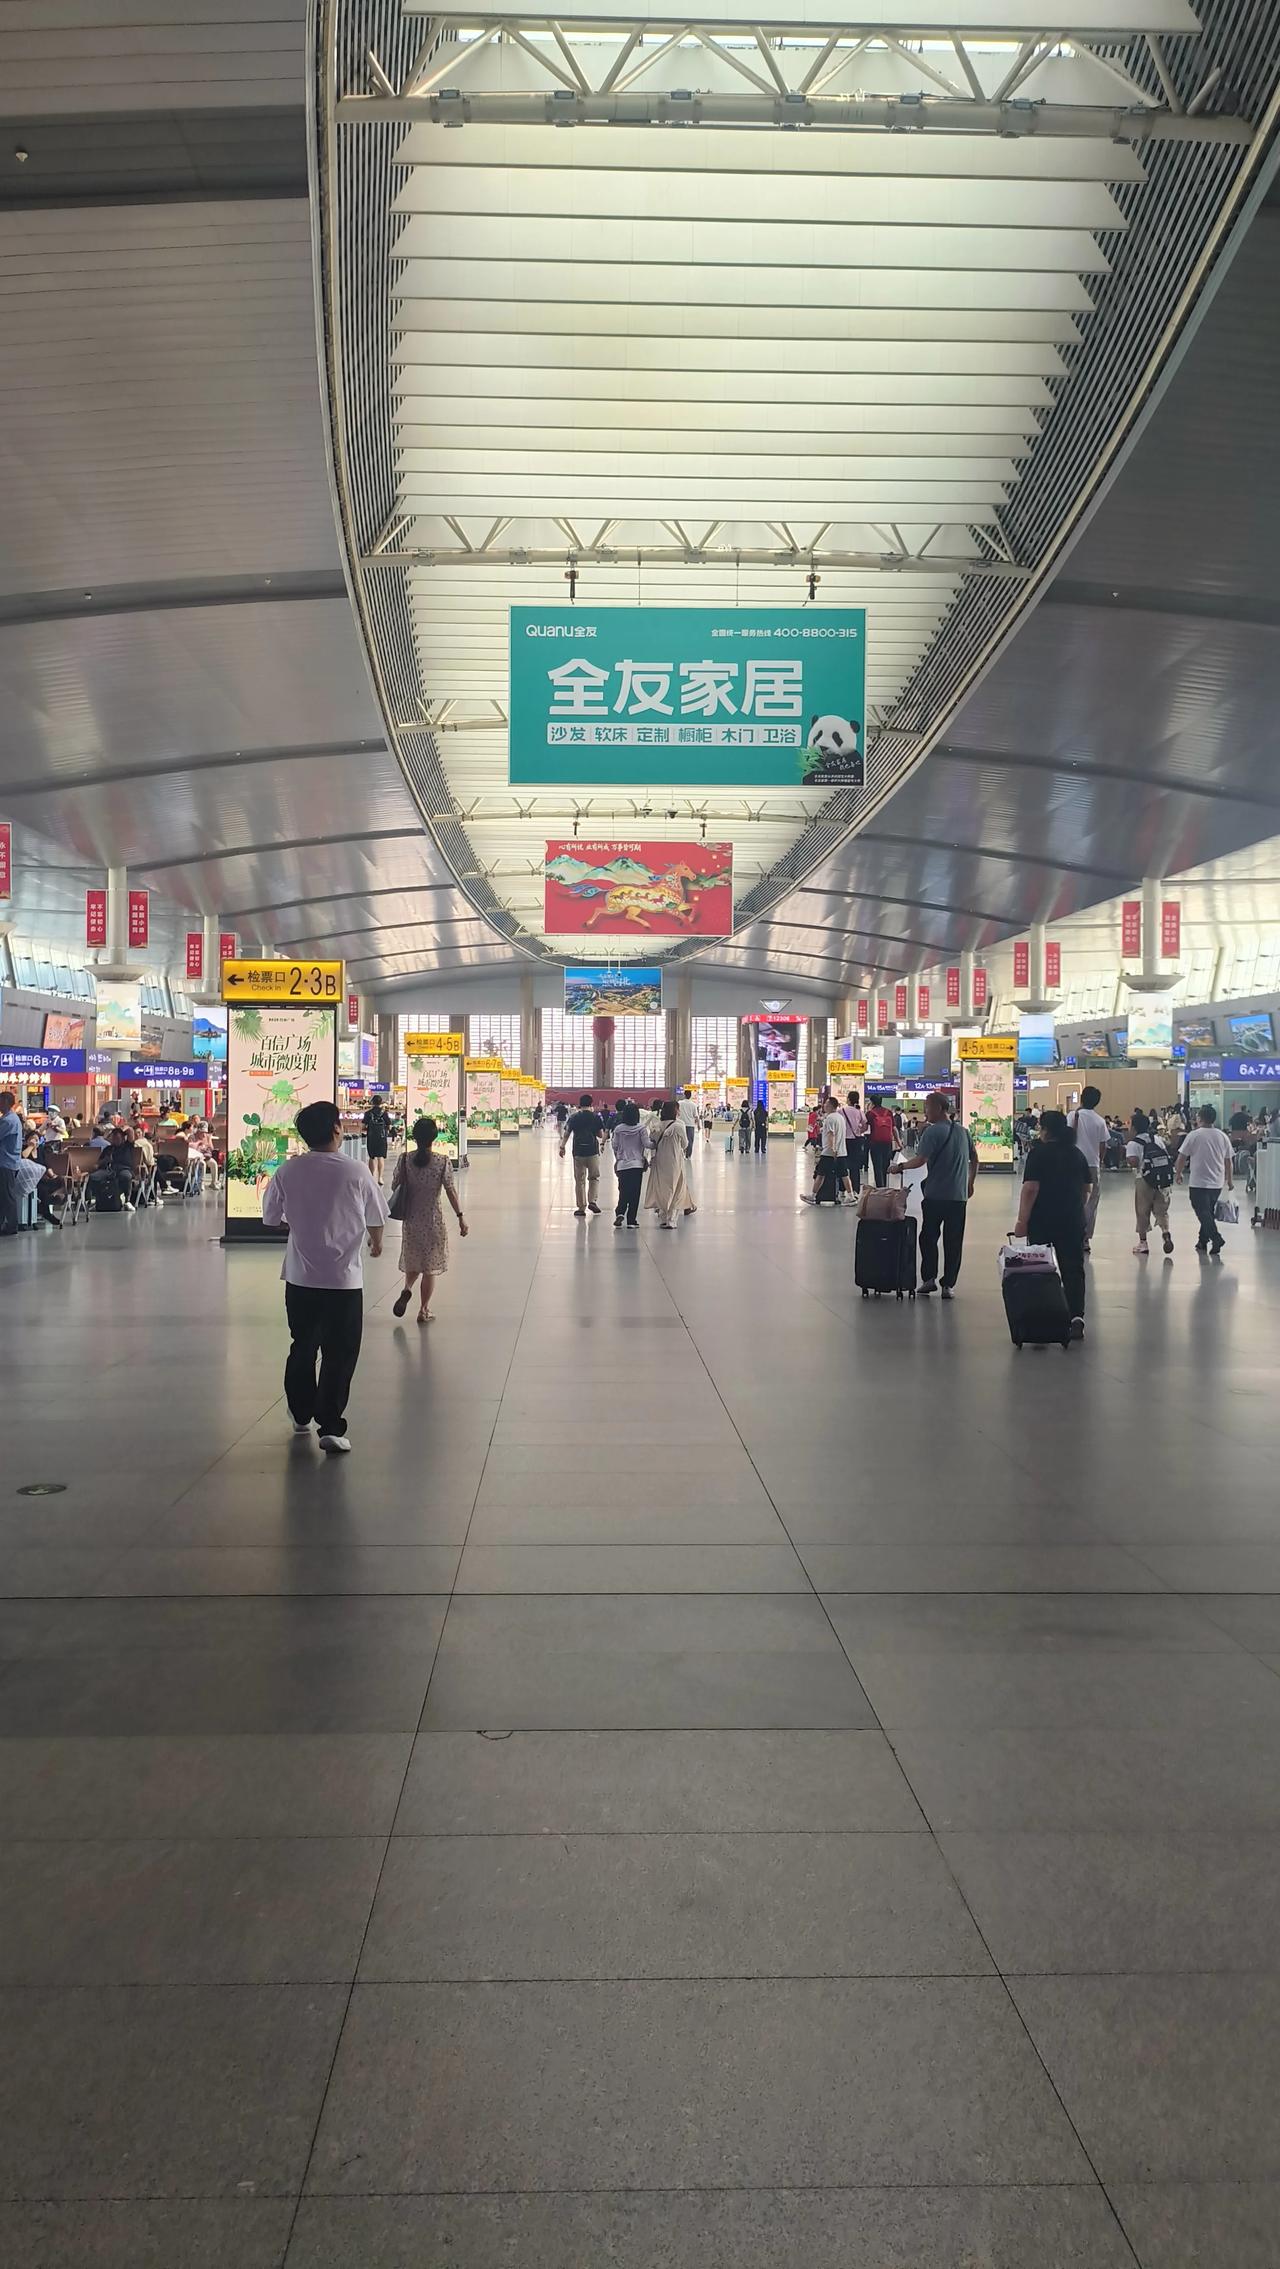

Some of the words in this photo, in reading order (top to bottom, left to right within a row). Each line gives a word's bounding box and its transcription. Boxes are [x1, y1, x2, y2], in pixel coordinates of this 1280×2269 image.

[711, 629, 771, 637] 全国统一服务热线
[773, 628, 857, 638] 400-8800-315
[547, 658, 803, 717] 全友家居
[551, 726, 586, 742] 沙发
[595, 727, 627, 742] 软床
[636, 727, 669, 743] 定制
[678, 727, 712, 743] 橱柜
[721, 728, 754, 743] 木门
[763, 728, 796, 743] 卫浴
[248, 970, 285, 983] 检票口
[251, 984, 273, 992] Check
[261, 1034, 311, 1052] 百信广场
[33, 1055, 68, 1067] 6B·7B
[250, 1051, 317, 1072] 城市微度假
[168, 1066, 194, 1075] 8B·9B
